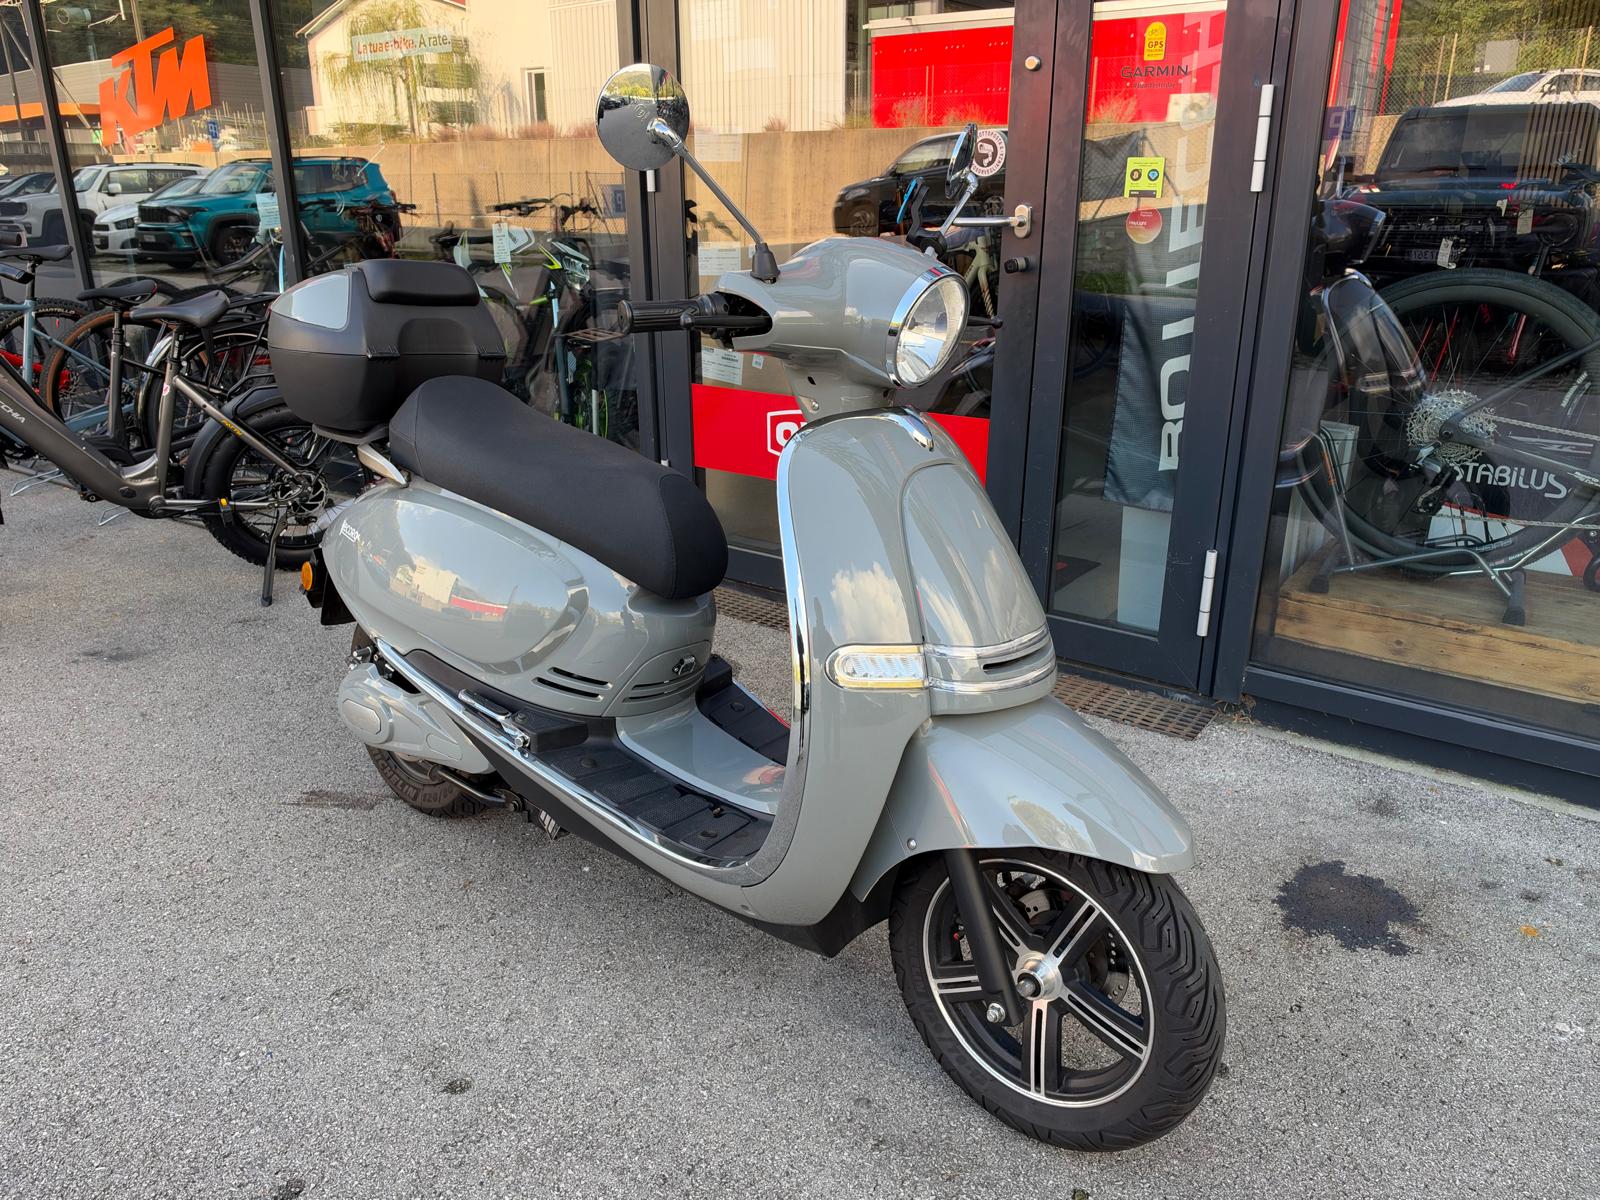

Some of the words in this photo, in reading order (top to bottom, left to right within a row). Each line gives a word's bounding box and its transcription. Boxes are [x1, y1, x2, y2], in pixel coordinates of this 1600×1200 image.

[418, 33, 427, 48] A
[428, 34, 451, 48] rate.
[1147, 40, 1164, 49] GPS
[1121, 65, 1189, 78] GARMIN
[98, 26, 212, 148] KTM
[38, 307, 76, 315] MARTELLO
